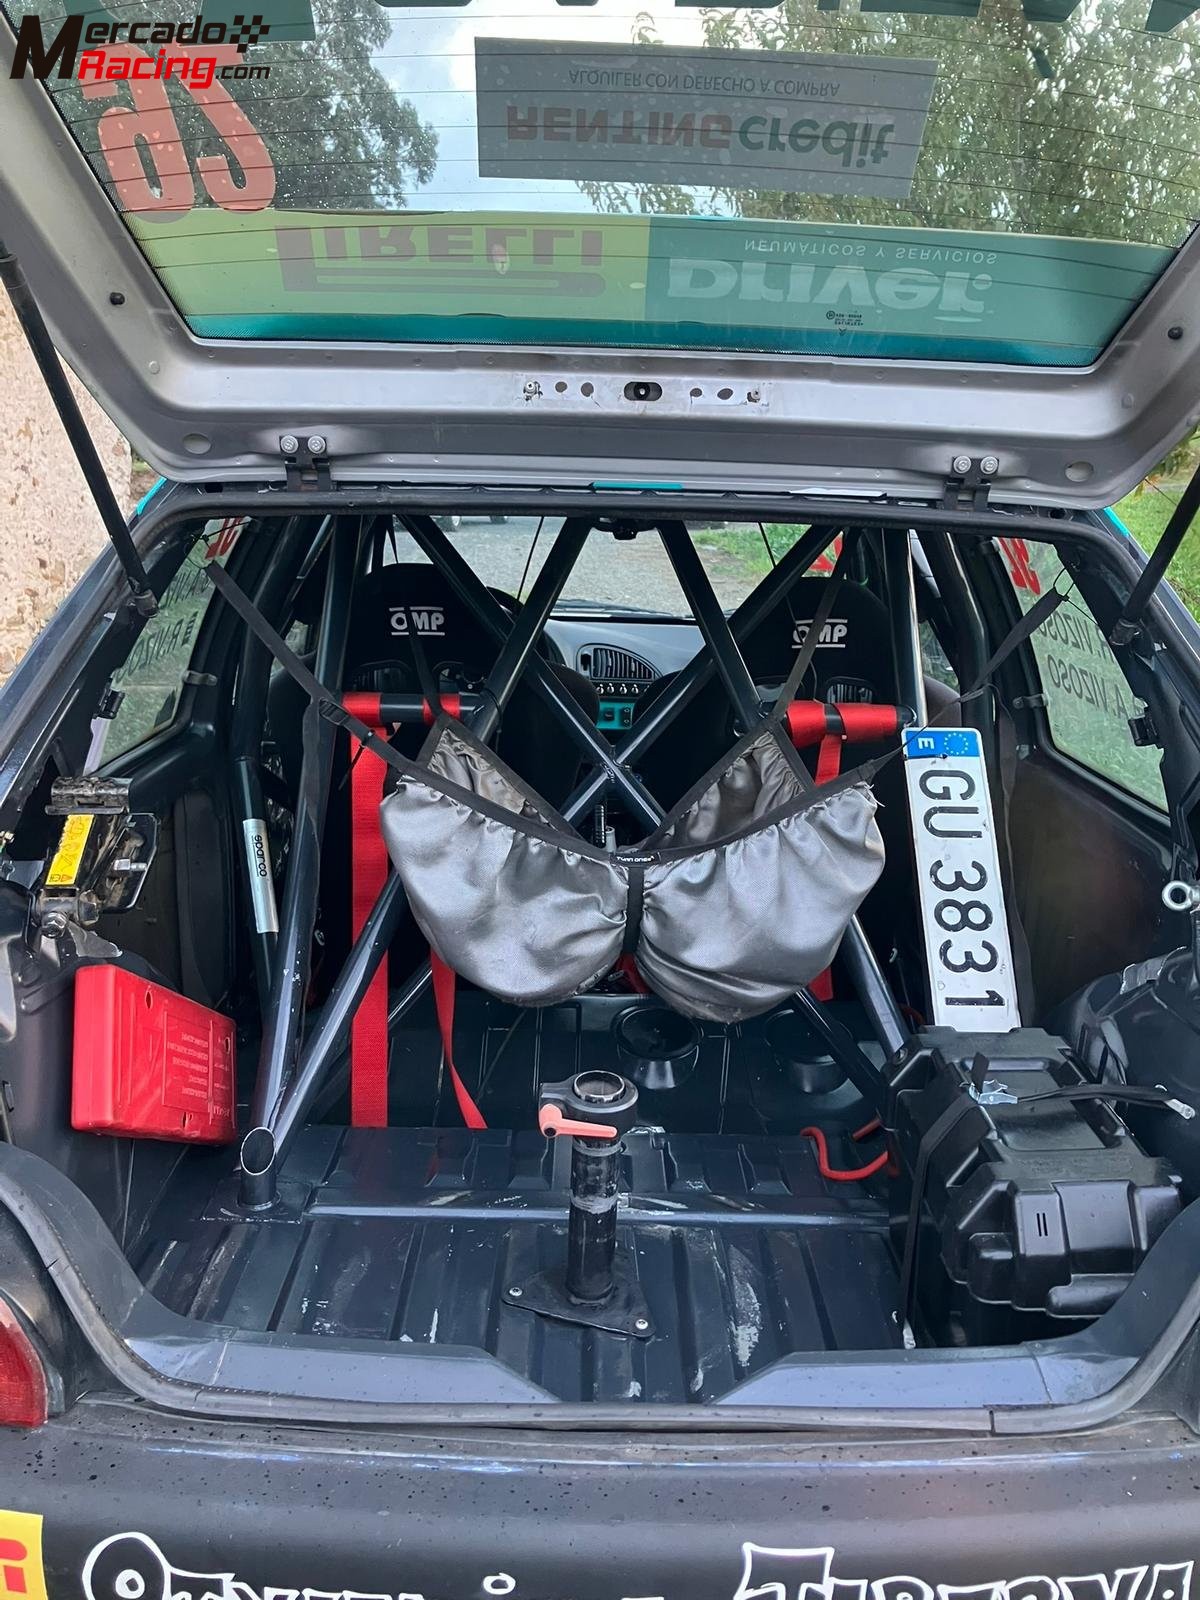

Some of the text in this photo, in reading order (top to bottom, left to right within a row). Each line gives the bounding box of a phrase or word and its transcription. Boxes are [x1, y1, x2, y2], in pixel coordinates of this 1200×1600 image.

[390, 611, 445, 631] OMP
[792, 624, 848, 643] OMP
[917, 737, 935, 750] E
[254, 834, 268, 877] sparco
[918, 769, 1006, 1006] GU 3831
